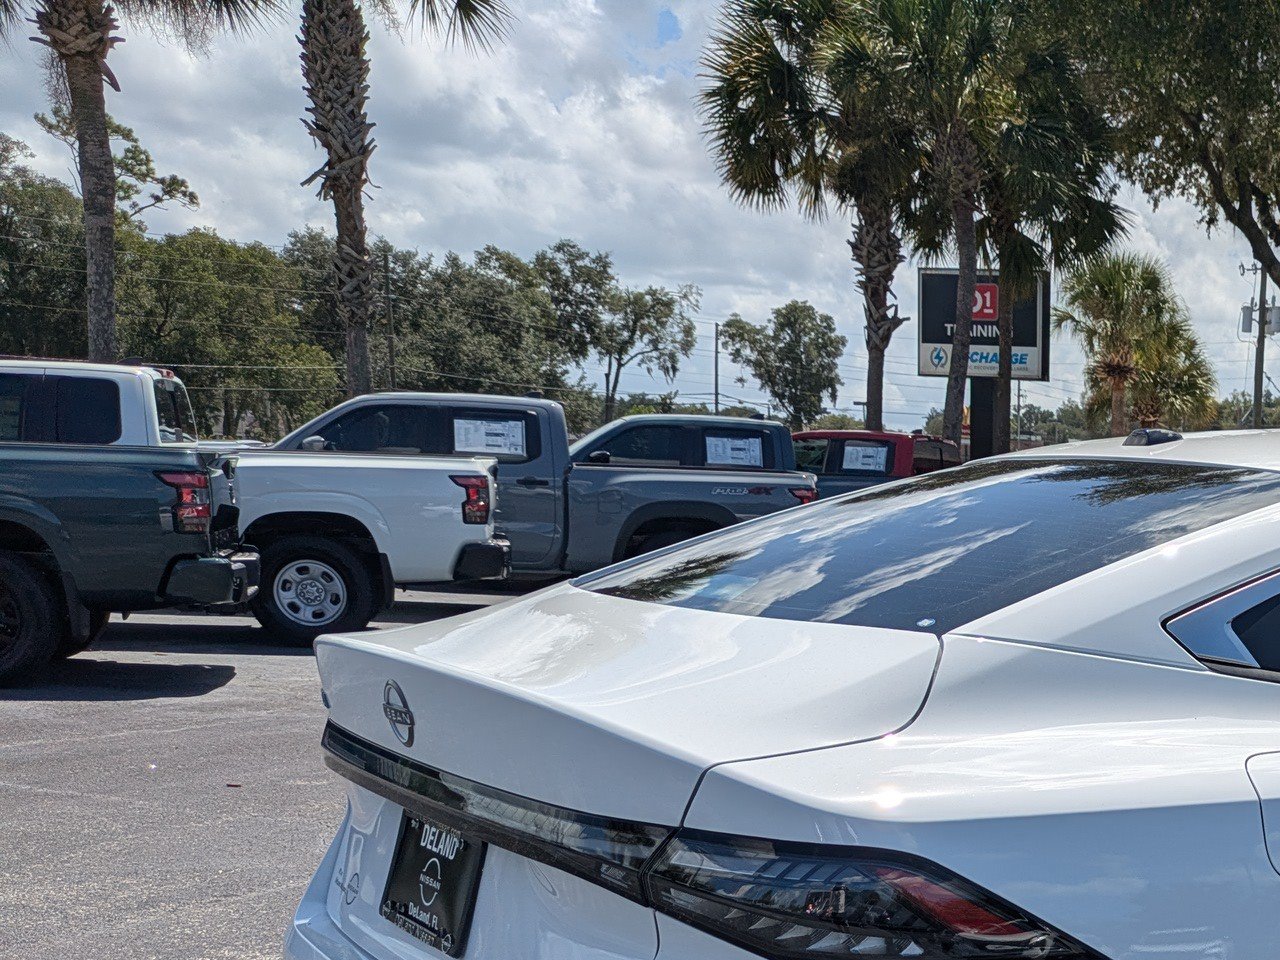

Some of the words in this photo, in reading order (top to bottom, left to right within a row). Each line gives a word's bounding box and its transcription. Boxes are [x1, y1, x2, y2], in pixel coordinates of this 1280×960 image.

[944, 323, 1013, 337] TININ
[968, 351, 1029, 365] CHAGE
[420, 824, 459, 860] DELAND
[419, 873, 442, 891] NISSAN
